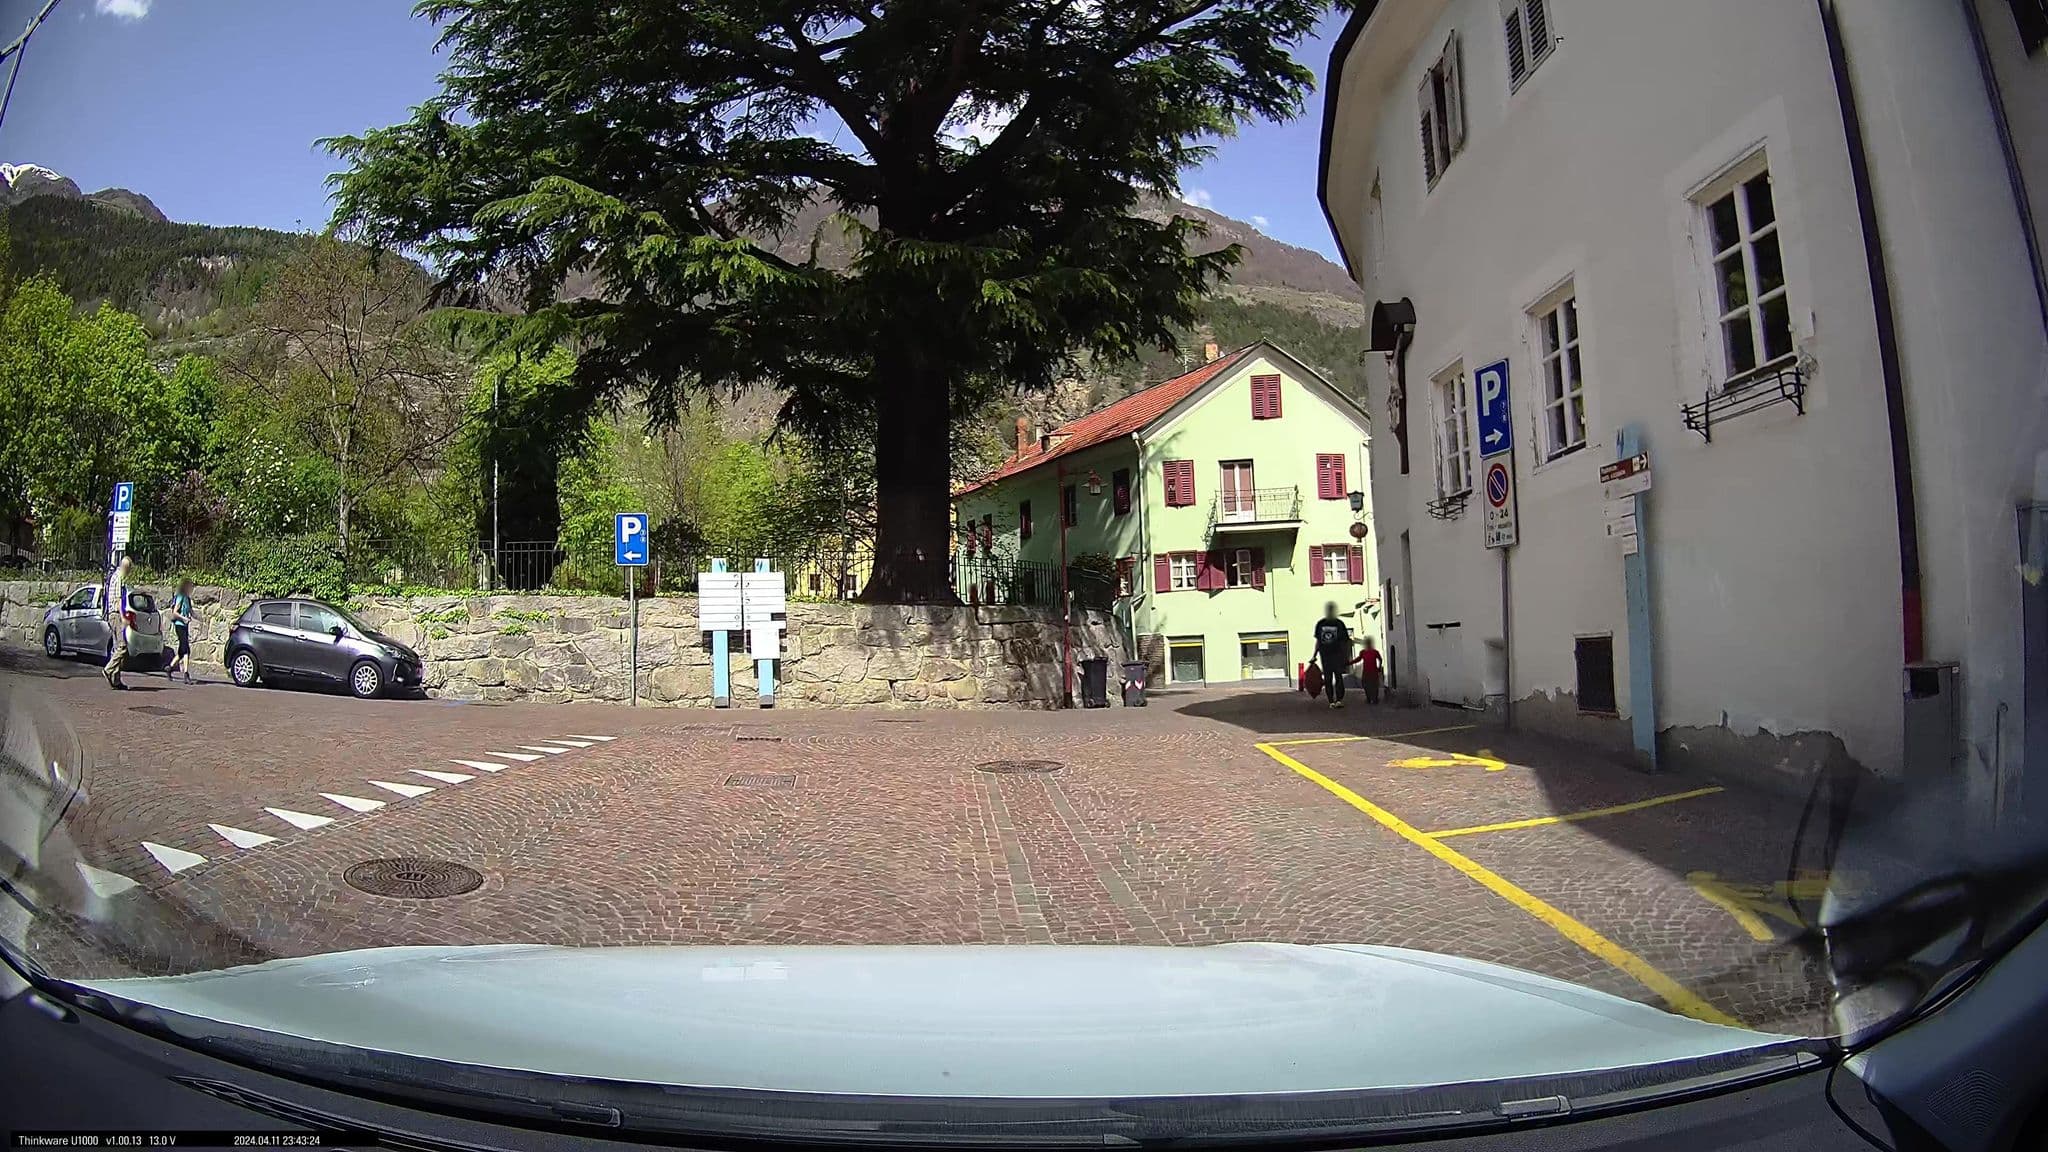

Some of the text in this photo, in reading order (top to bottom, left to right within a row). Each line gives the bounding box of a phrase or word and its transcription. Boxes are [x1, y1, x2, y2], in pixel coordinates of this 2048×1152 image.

[1480, 370, 1501, 416] P
[117, 486, 129, 510] P
[622, 517, 641, 543] P
